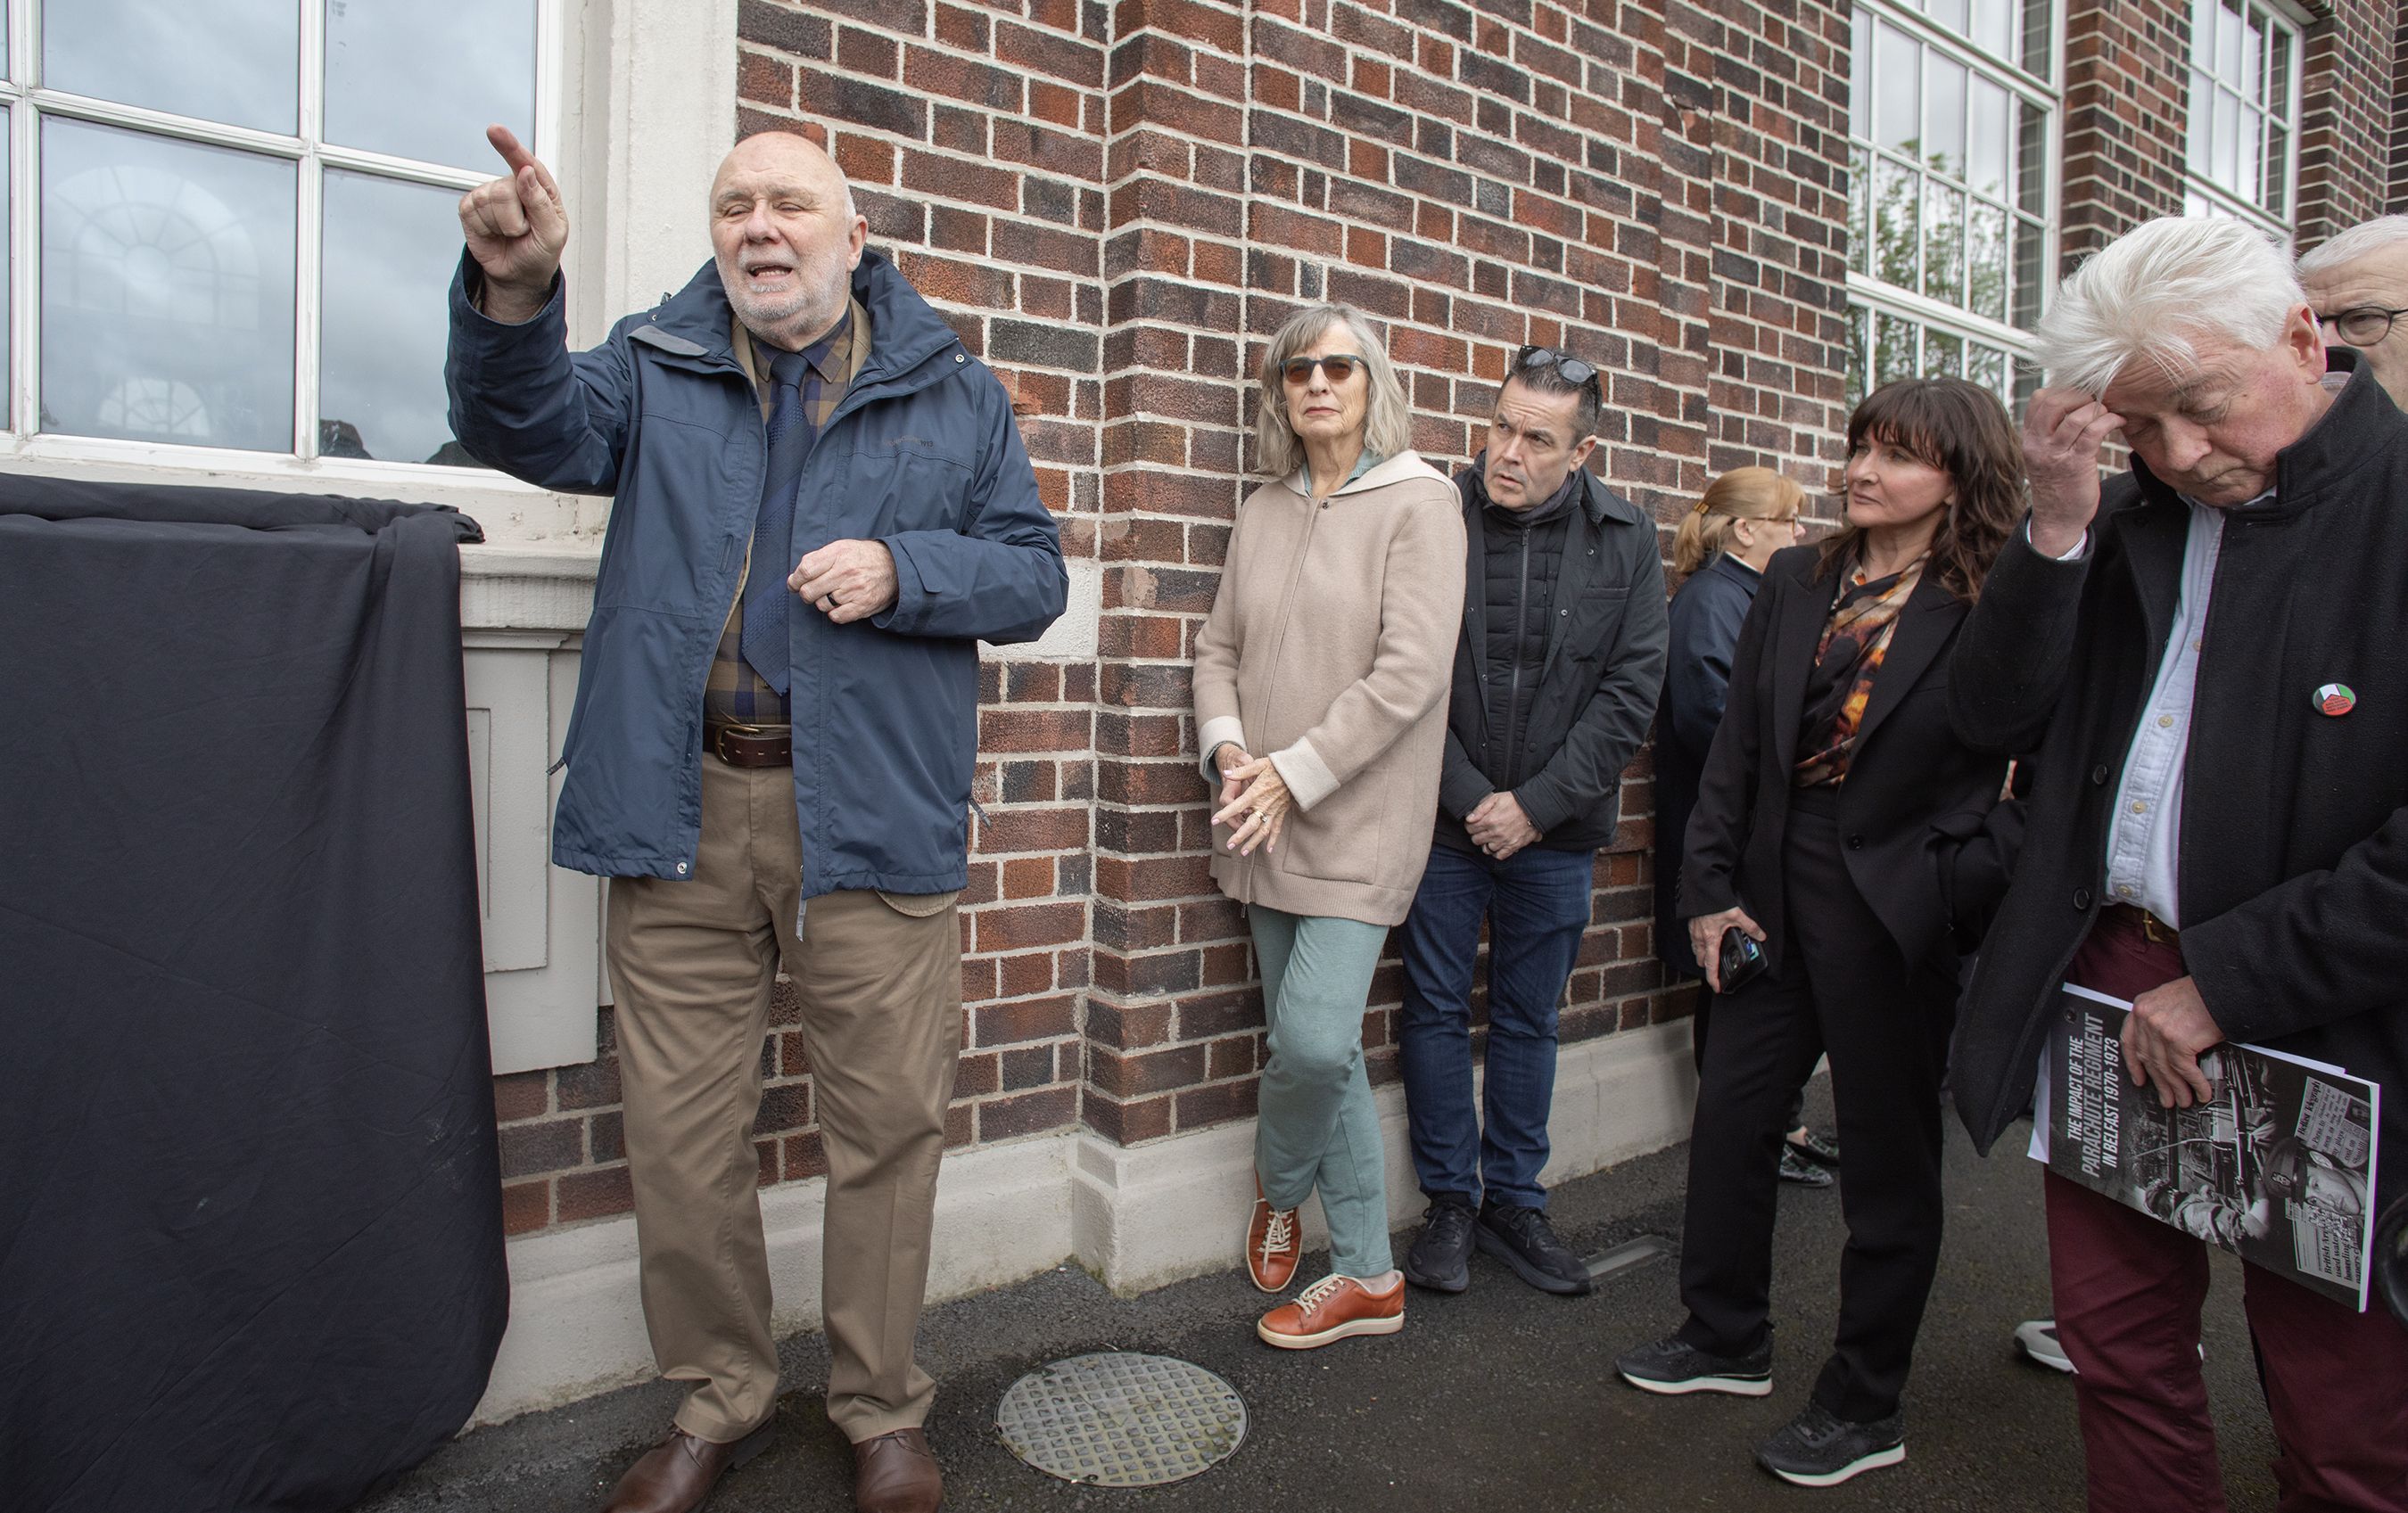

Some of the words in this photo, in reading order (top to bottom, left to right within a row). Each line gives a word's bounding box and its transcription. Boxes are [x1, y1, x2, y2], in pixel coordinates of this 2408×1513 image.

[2069, 1035, 2083, 1059] THE
[2083, 1012, 2103, 1090] REGIMENT
[2069, 1058, 2082, 1076] OF
[2104, 1037, 2119, 1101] 1970-1973
[2068, 1074, 2082, 1120] IMPACT
[2297, 1113, 2311, 1135] Belfast
[2305, 1080, 2321, 1113] Telegraph
[2067, 1117, 2082, 1141] THE
[2082, 1089, 2102, 1178] PARACHUTE
[2103, 1102, 2119, 1154] BELFAST
[2102, 1152, 2117, 1168] IN
[2321, 1246, 2333, 1275] British
[2332, 1257, 2342, 1278] used
